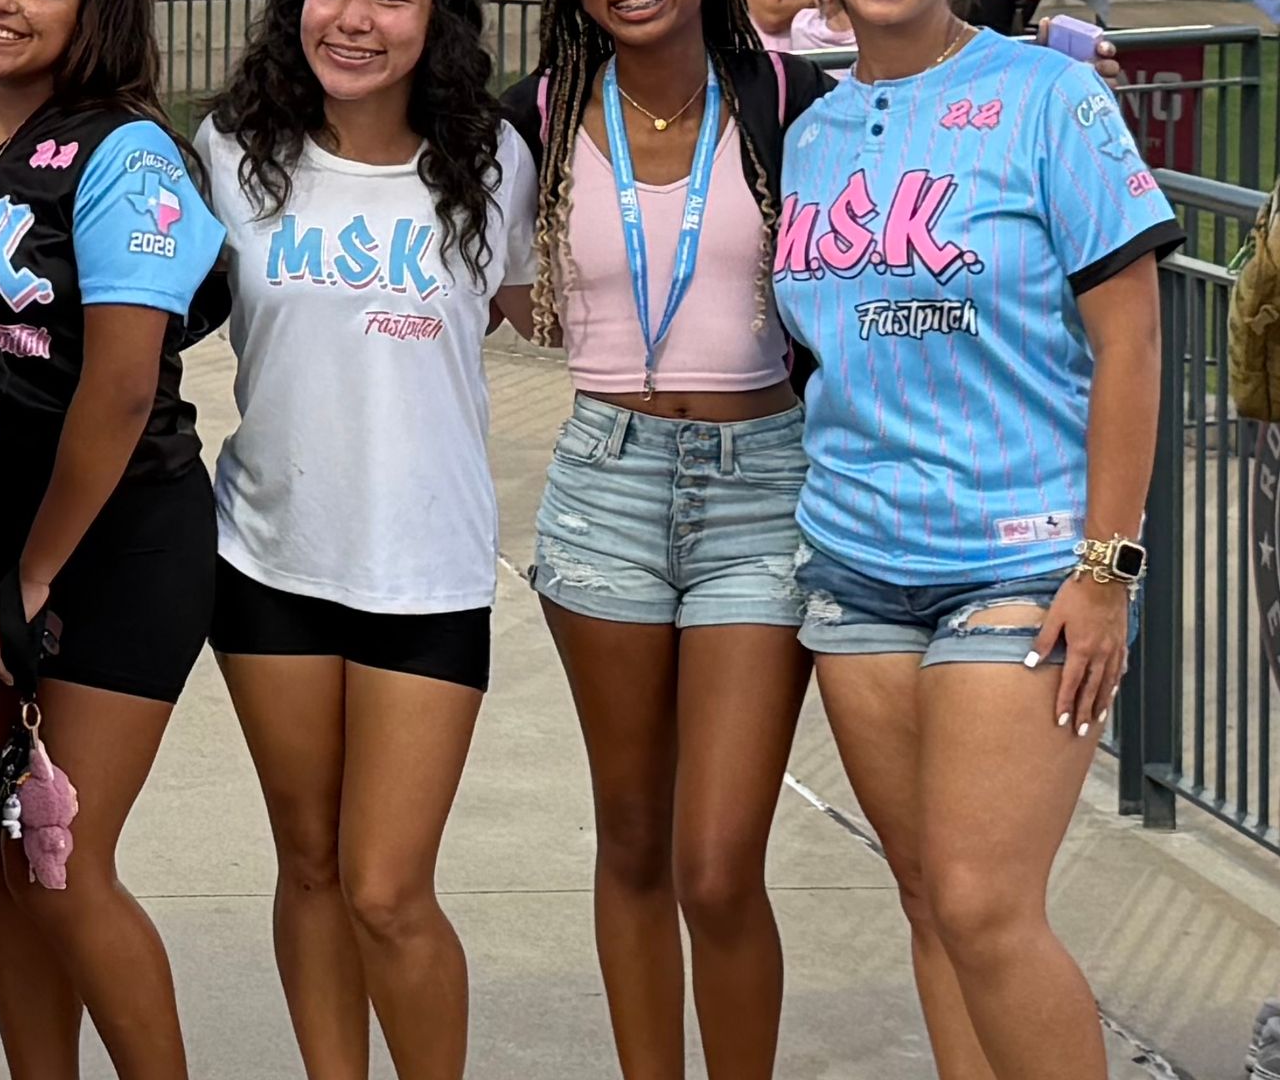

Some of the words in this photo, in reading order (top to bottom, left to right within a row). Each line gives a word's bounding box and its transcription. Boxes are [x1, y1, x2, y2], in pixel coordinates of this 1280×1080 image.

[940, 97, 1003, 131] 22
[1126, 170, 1158, 198] 20
[128, 231, 176, 258] 2028
[266, 212, 450, 303] M.S.K.
[364, 310, 444, 341] Fastpitch
[854, 297, 980, 342] Fastpitch
